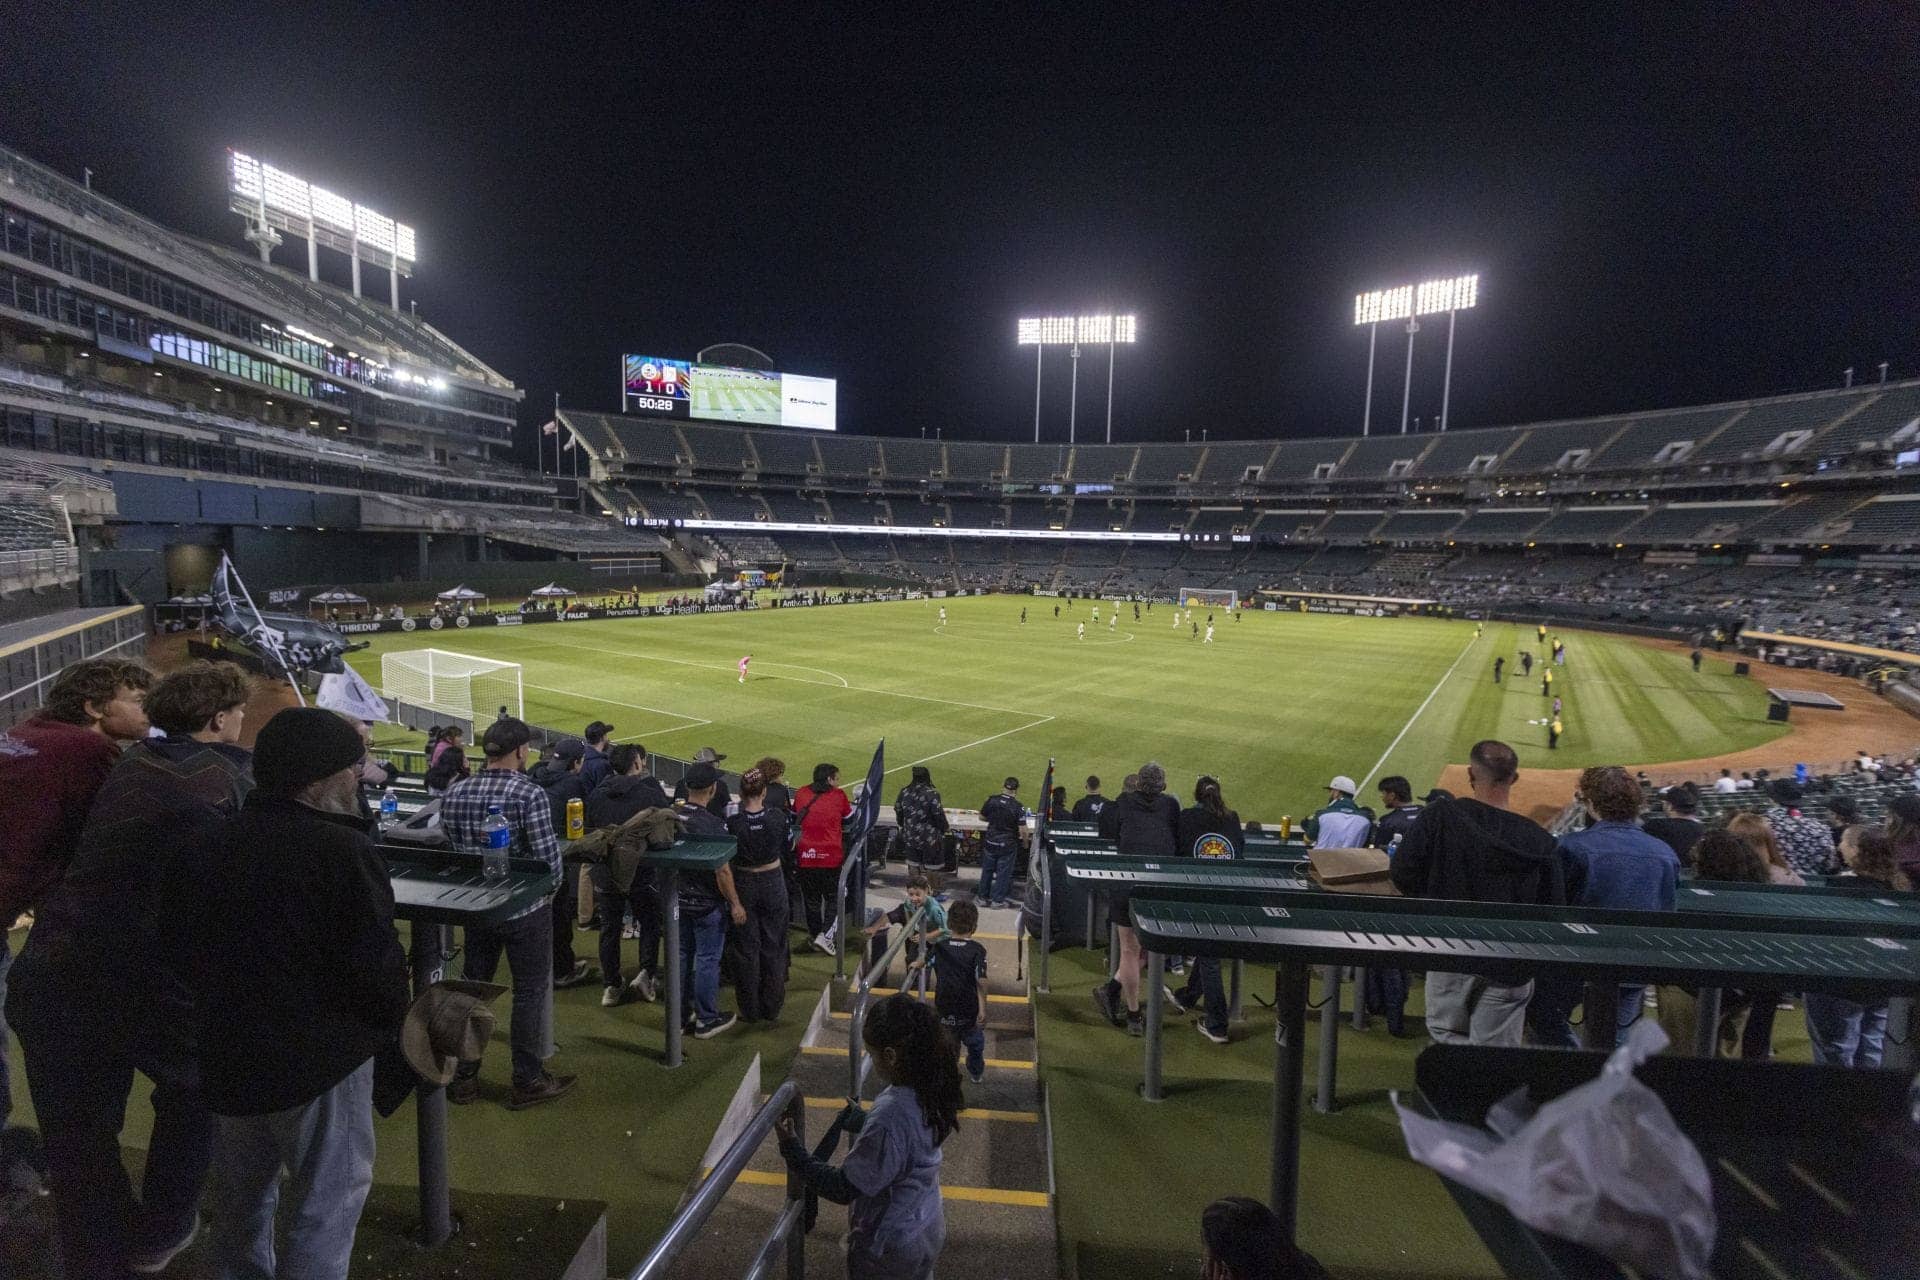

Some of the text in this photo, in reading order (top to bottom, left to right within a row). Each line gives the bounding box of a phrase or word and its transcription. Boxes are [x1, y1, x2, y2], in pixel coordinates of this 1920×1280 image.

[646, 381, 675, 395] 1 0
[639, 398, 673, 411] 50:28
[1100, 594, 1125, 602] Anthem
[606, 608, 639, 617] Penumbra
[673, 603, 700, 614] Health
[704, 603, 734, 613] Anthem
[341, 622, 381, 633] THREDUP
